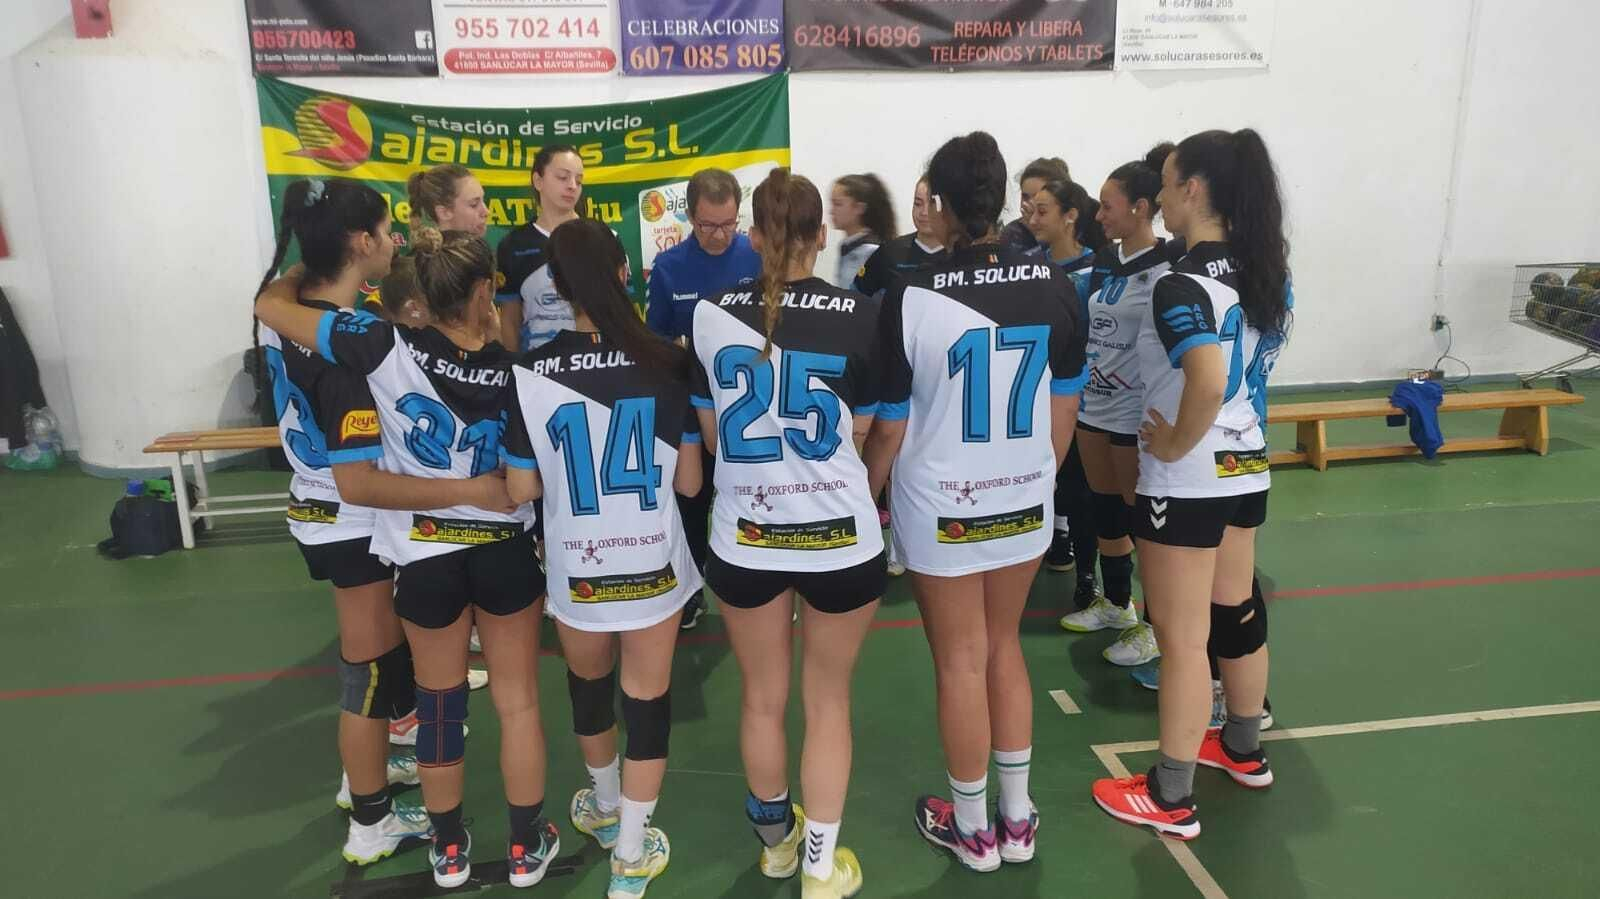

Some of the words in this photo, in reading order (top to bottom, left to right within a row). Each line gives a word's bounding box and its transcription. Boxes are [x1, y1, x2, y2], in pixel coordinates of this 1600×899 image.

[455, 17, 499, 39] 955
[507, 17, 550, 39] 702
[558, 17, 600, 39] 414
[627, 18, 780, 36] CELEBRACIONES
[793, 24, 921, 48] 628416896
[954, 20, 1012, 38] REPARA
[1016, 20, 1027, 37] Y
[1030, 19, 1084, 37] LIBERA
[629, 45, 674, 70] 607
[683, 44, 729, 69] 085
[736, 43, 782, 68] 805
[930, 43, 1023, 64] TELÉFONOS
[1023, 45, 1036, 62] Y
[1038, 43, 1105, 62] TABLETS
[1120, 50, 1264, 62] www.solucarasesores.es
[518, 120, 544, 136] de
[554, 114, 643, 136] Servicio
[933, 272, 969, 289] BM.
[973, 264, 1051, 285] SOLUCAR
[719, 292, 753, 307] BM.
[533, 356, 565, 378] BM.
[946, 324, 1052, 443] 17
[713, 344, 848, 463] 25
[545, 396, 663, 517] 14
[733, 485, 754, 496] THE
[767, 483, 810, 496] OXFORD
[811, 479, 849, 493] SCHOOL
[938, 480, 960, 491] THE
[975, 477, 1012, 490] OXFORD
[561, 540, 585, 551] THE
[598, 537, 638, 550] OXFORD
